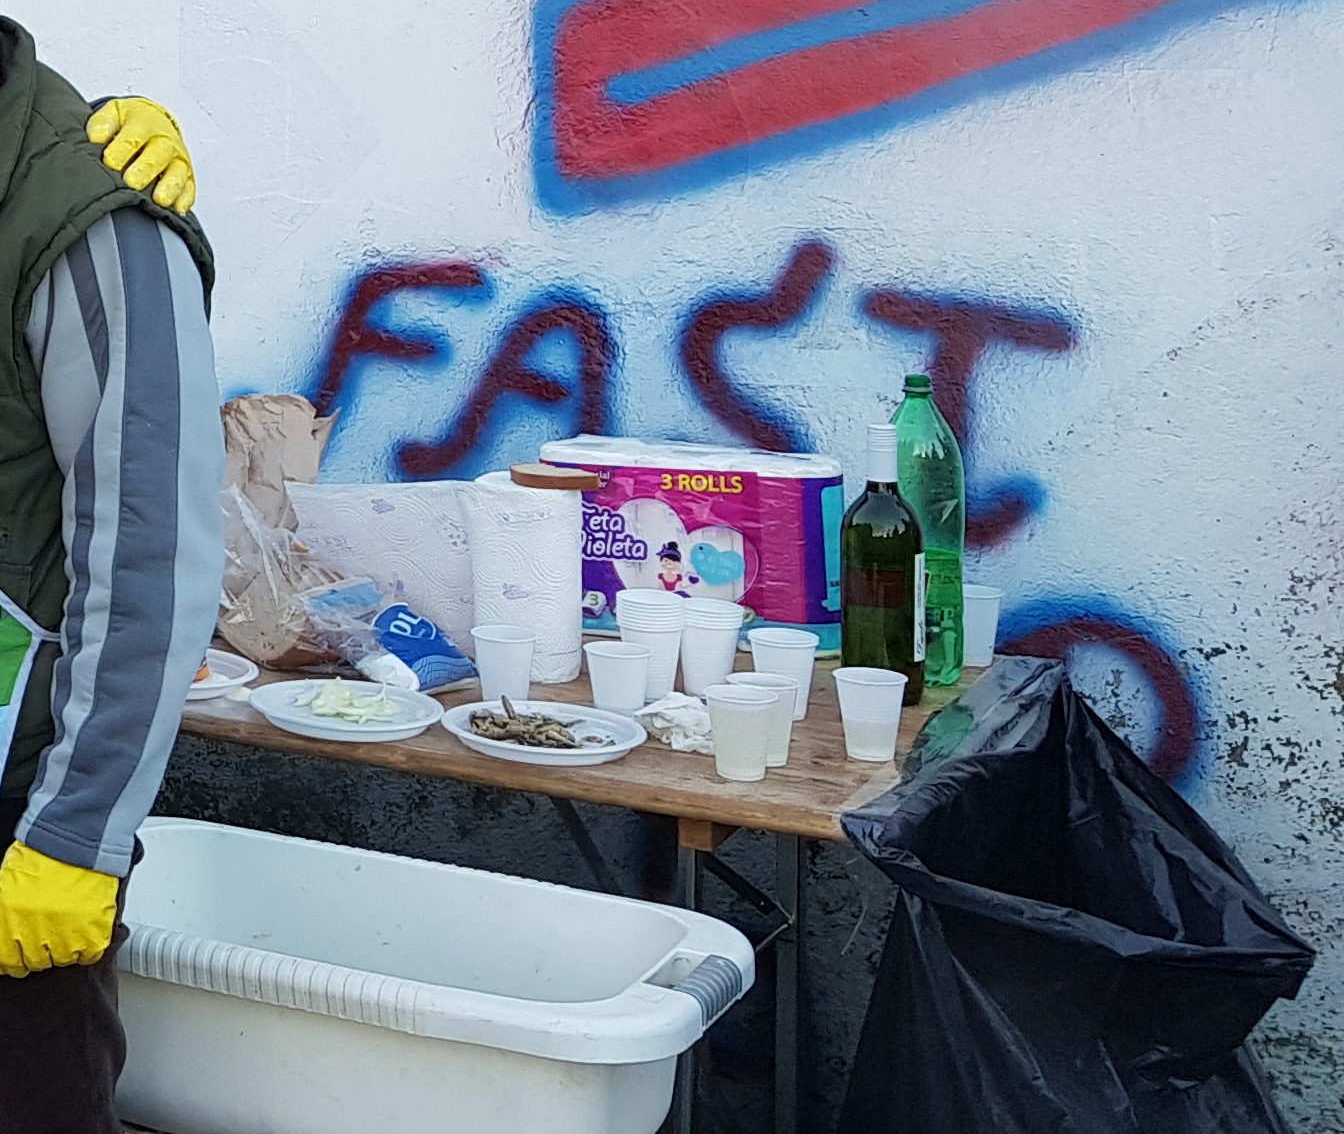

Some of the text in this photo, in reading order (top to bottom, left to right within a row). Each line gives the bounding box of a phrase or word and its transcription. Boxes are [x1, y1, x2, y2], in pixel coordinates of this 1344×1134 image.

[660, 473, 744, 493] 3 ROLLS
[589, 593, 600, 606] 3
